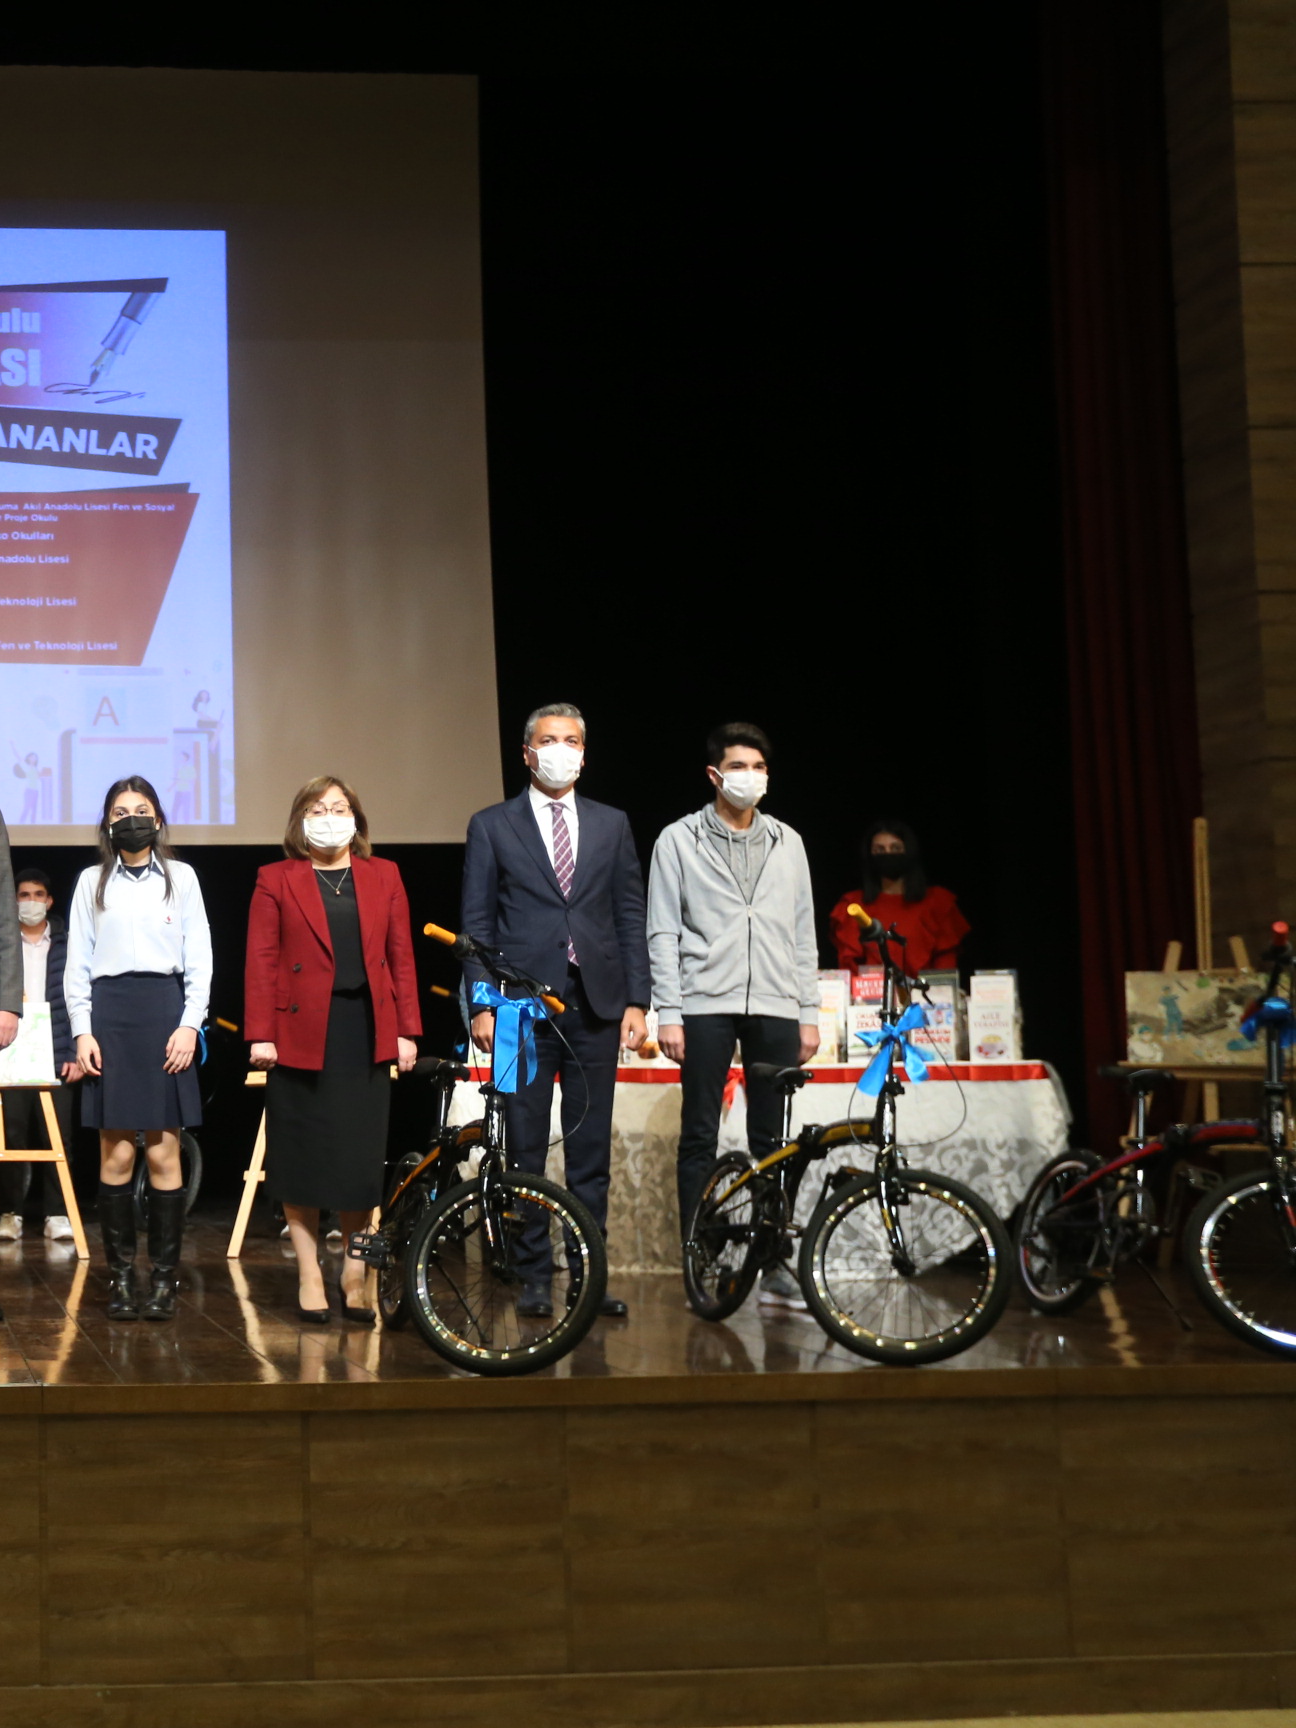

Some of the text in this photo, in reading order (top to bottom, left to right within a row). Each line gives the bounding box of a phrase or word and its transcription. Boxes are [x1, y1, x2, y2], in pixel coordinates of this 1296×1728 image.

[44, 503, 83, 511] Anadolu
[112, 503, 130, 511] Fen
[144, 503, 175, 512] Sosyal
[4, 513, 29, 523] Proje
[30, 514, 58, 522] Okulu
[11, 531, 54, 541] Okulları
[38, 554, 70, 564] Lisesi
[46, 597, 77, 606] Lisesi
[18, 642, 31, 650] ve
[33, 640, 84, 652] Teknoloji
[87, 641, 118, 651] Lisesi
[92, 695, 120, 727] A
